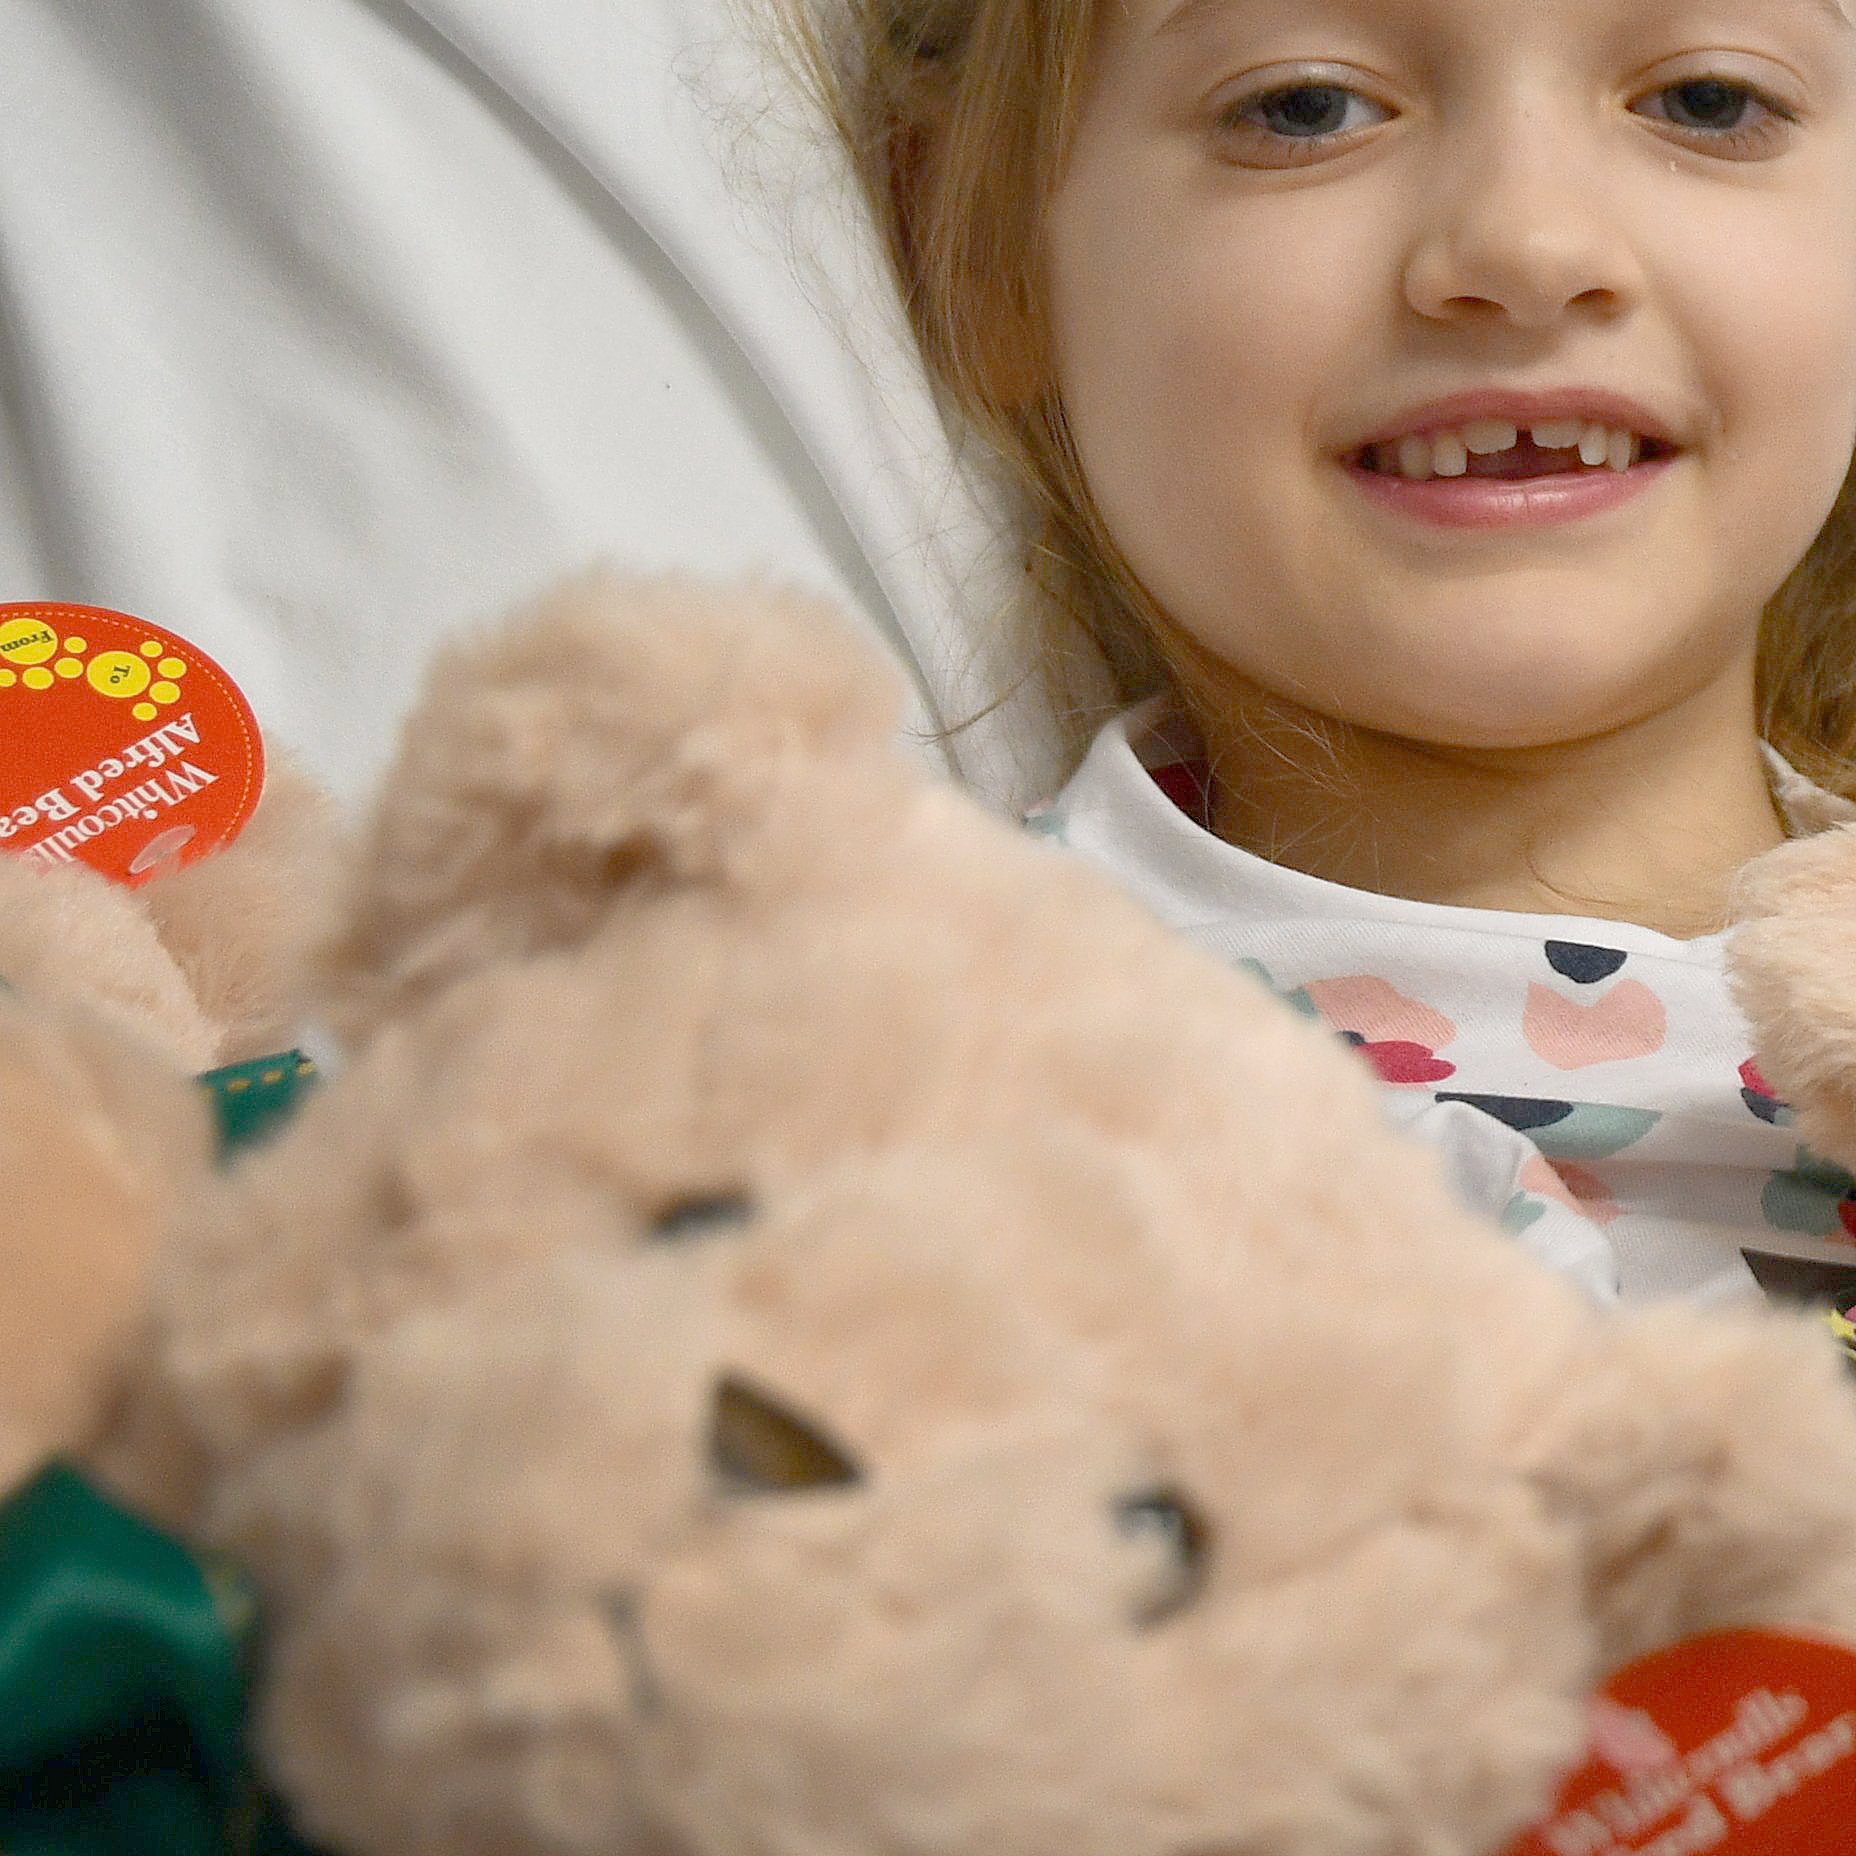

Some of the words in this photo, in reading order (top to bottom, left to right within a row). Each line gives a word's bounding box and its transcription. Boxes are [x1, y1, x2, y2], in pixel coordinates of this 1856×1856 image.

[0, 630, 54, 653] From
[109, 665, 131, 686] To
[69, 712, 202, 804] Alfred
[23, 760, 220, 864] Whitcoull
